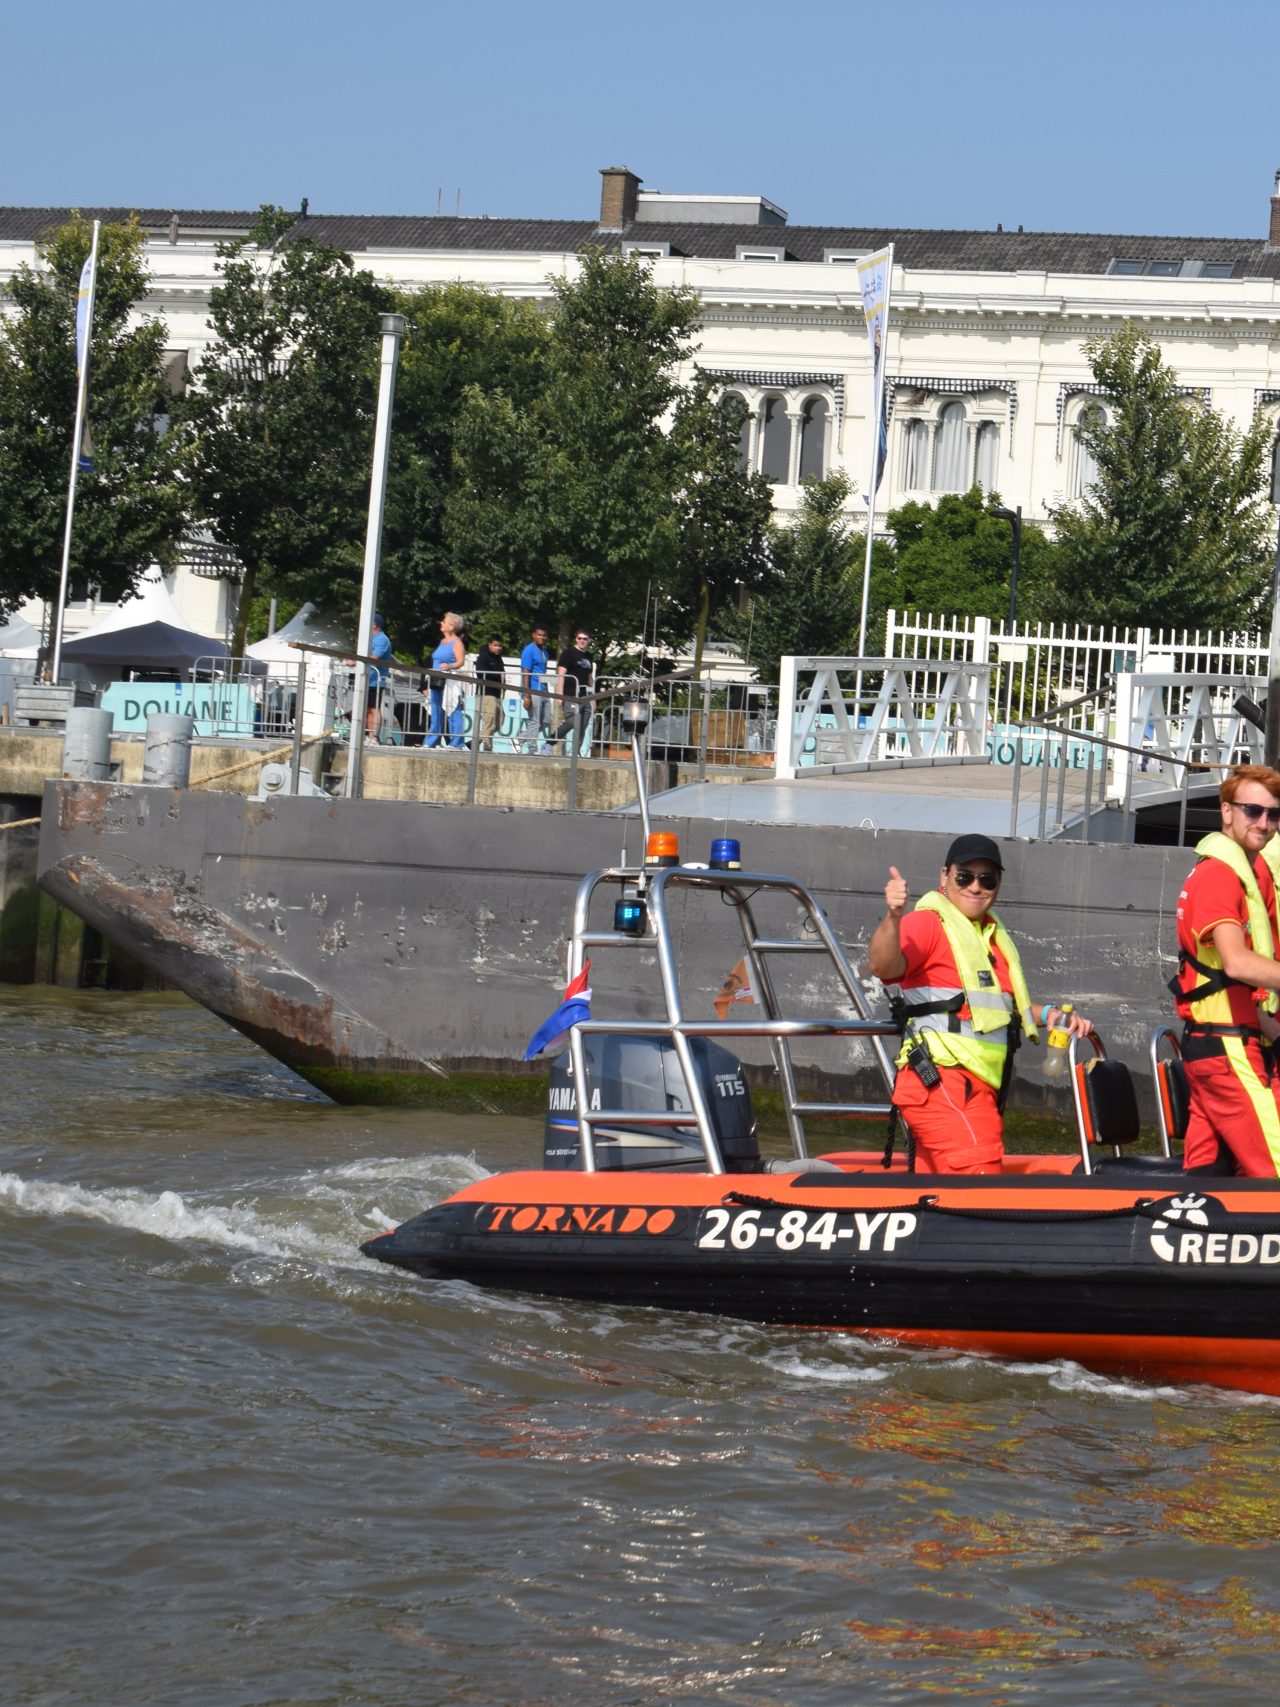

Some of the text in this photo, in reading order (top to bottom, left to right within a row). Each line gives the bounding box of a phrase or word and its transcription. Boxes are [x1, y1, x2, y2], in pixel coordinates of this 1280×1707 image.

[124, 700, 233, 721] DOUANE
[549, 1088, 601, 1110] YAMAA
[717, 1080, 745, 1096] 115
[488, 1206, 677, 1235] TORNADO
[699, 1209, 917, 1251] 26-84-YP
